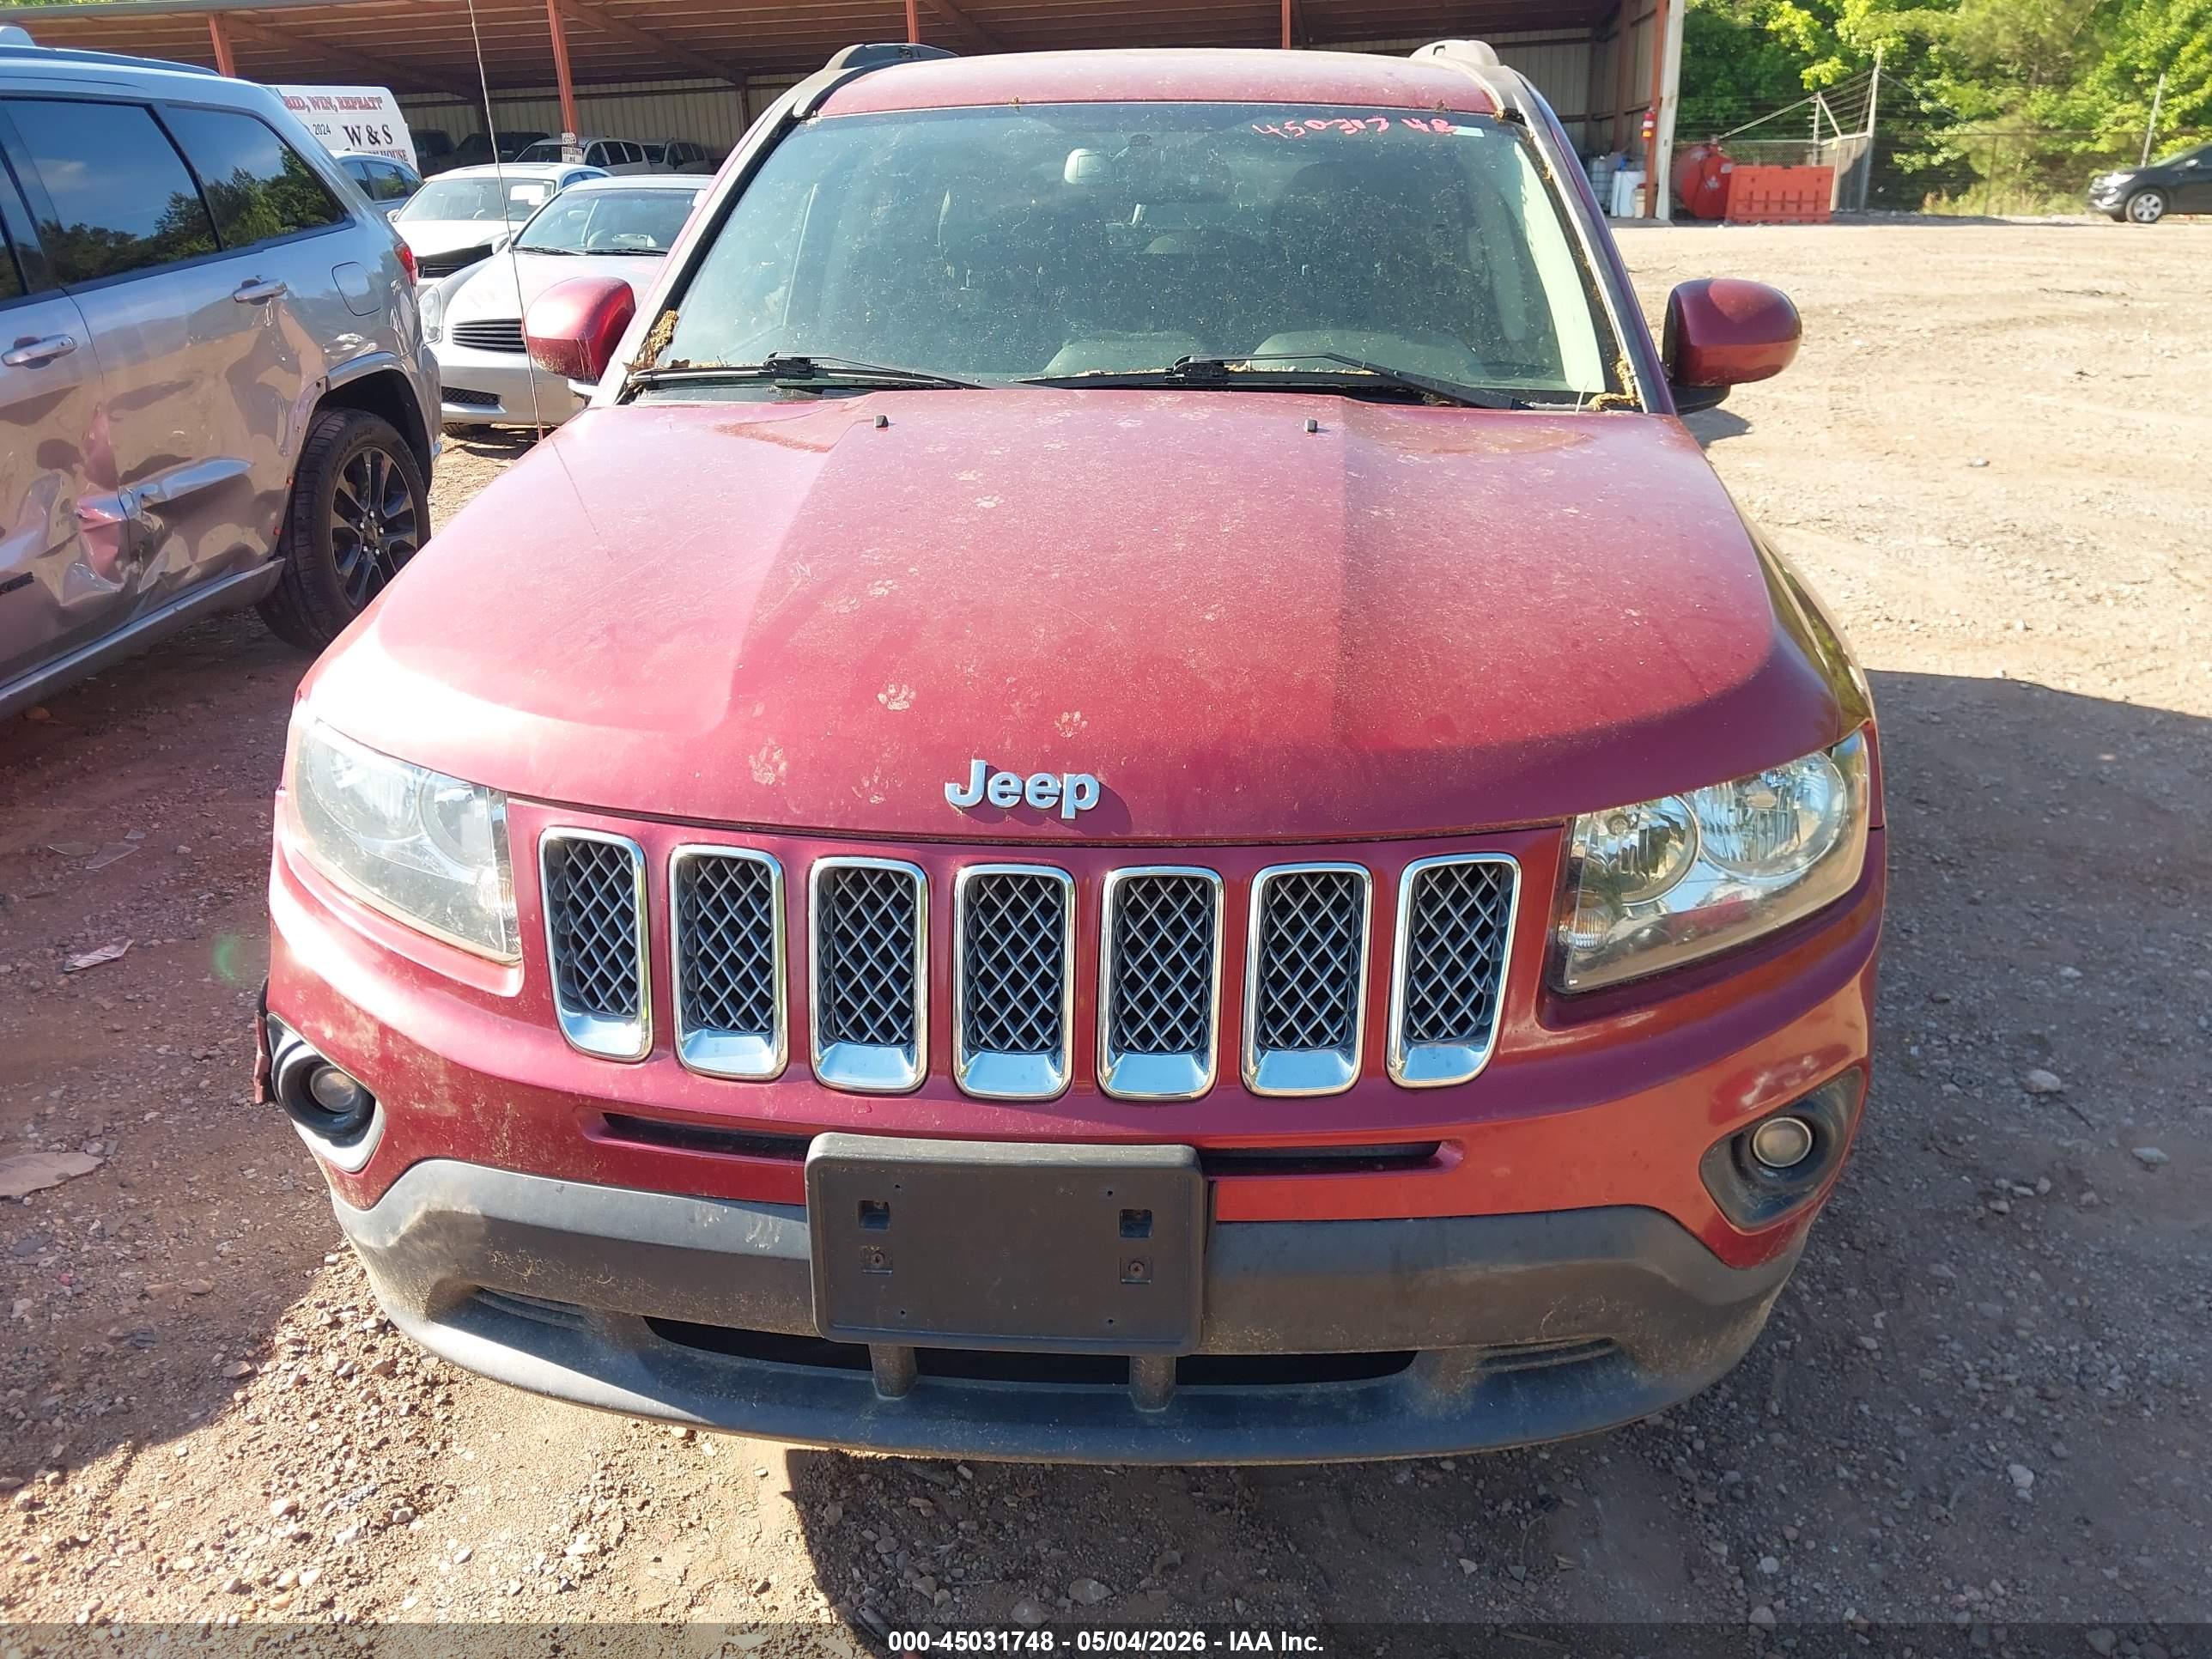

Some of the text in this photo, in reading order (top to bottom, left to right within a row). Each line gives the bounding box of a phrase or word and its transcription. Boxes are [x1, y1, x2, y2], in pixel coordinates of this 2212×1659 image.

[313, 124, 331, 135] 2024
[342, 125, 393, 146] W & S
[944, 758, 1100, 820] Jeep
